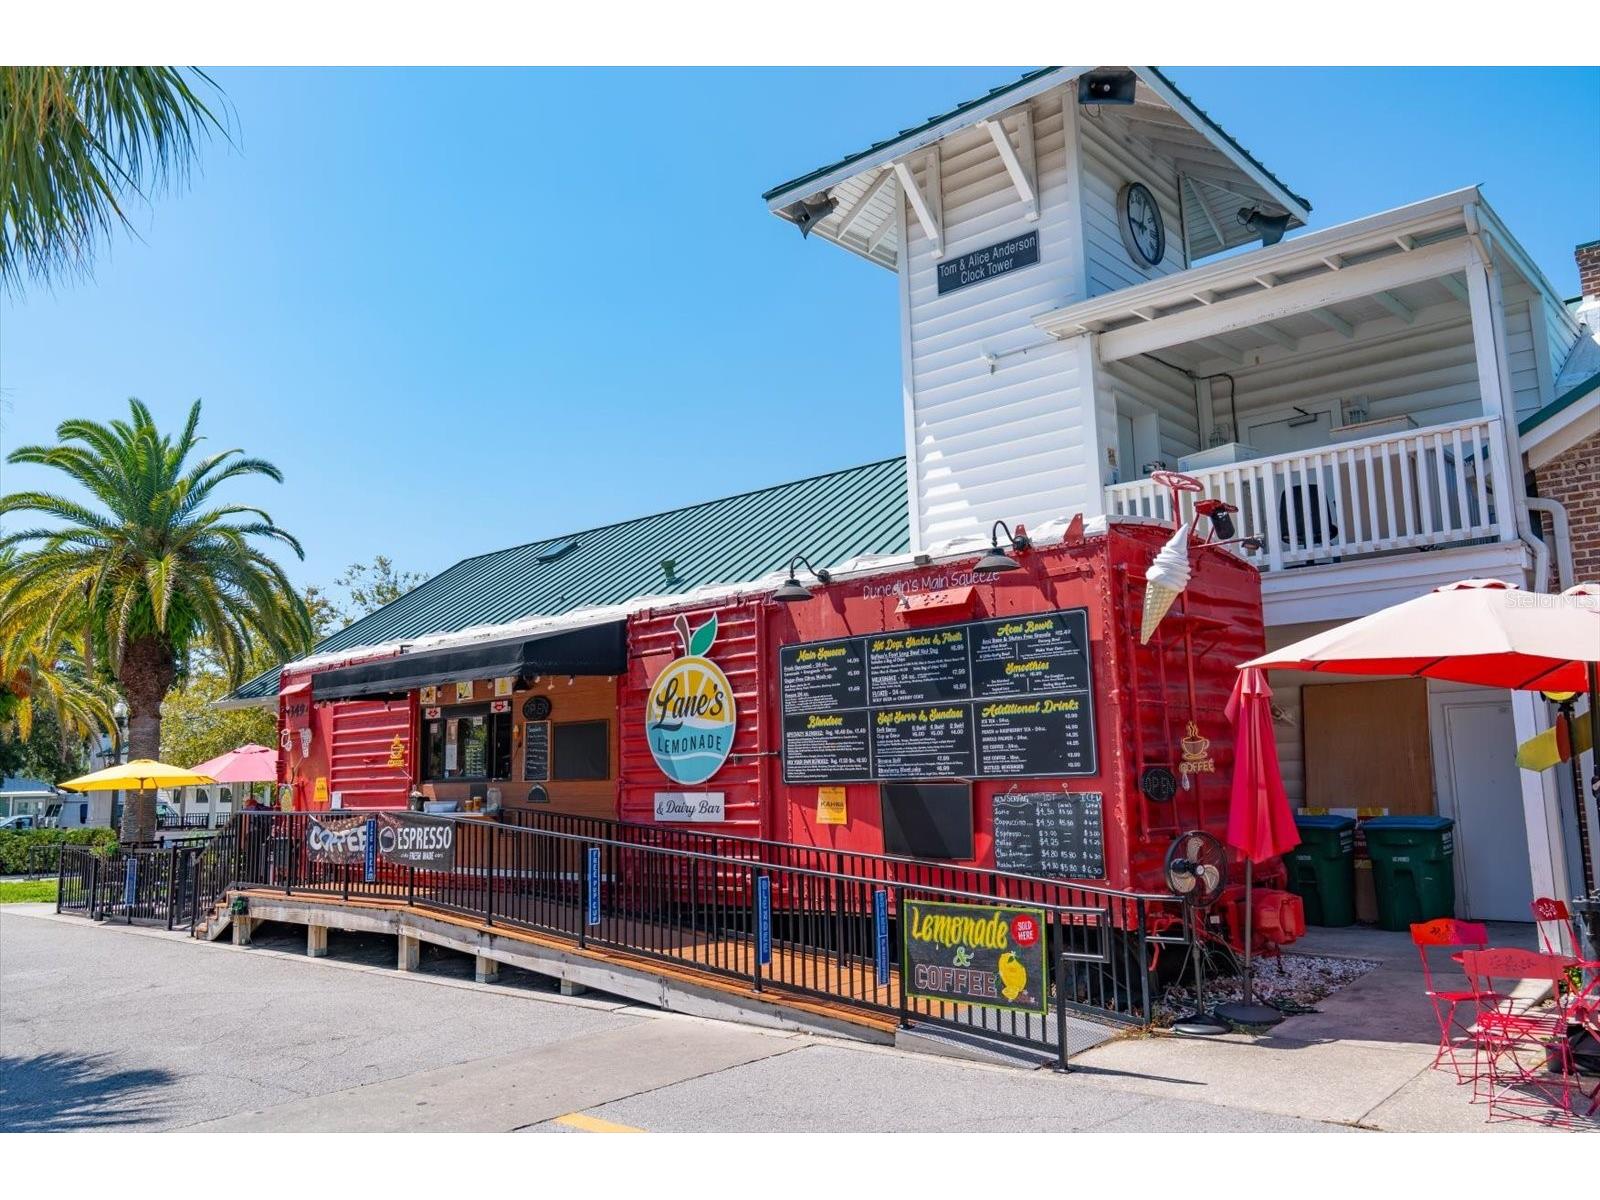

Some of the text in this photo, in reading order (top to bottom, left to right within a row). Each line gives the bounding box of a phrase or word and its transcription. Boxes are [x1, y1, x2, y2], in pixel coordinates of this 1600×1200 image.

[940, 236, 1035, 277] Tom & Alice Anderson
[961, 257, 1013, 283] Clock Tower
[863, 571, 1000, 600] Dunedin's Main Squeeze
[796, 649, 816, 662] Main
[652, 677, 724, 731] Lane's
[982, 699, 1079, 717] Additional Drinks
[918, 710, 928, 722] &
[657, 734, 722, 754] LEMONADE
[656, 799, 721, 818] & Dairy Bar
[309, 825, 367, 852] COFFEE
[397, 826, 452, 850] ESPRESSO
[912, 906, 1009, 949] Lemonade
[1017, 921, 1032, 931] SOLD
[1018, 930, 1033, 940] HERE
[952, 946, 974, 967] &
[915, 964, 997, 998] COFFEE
